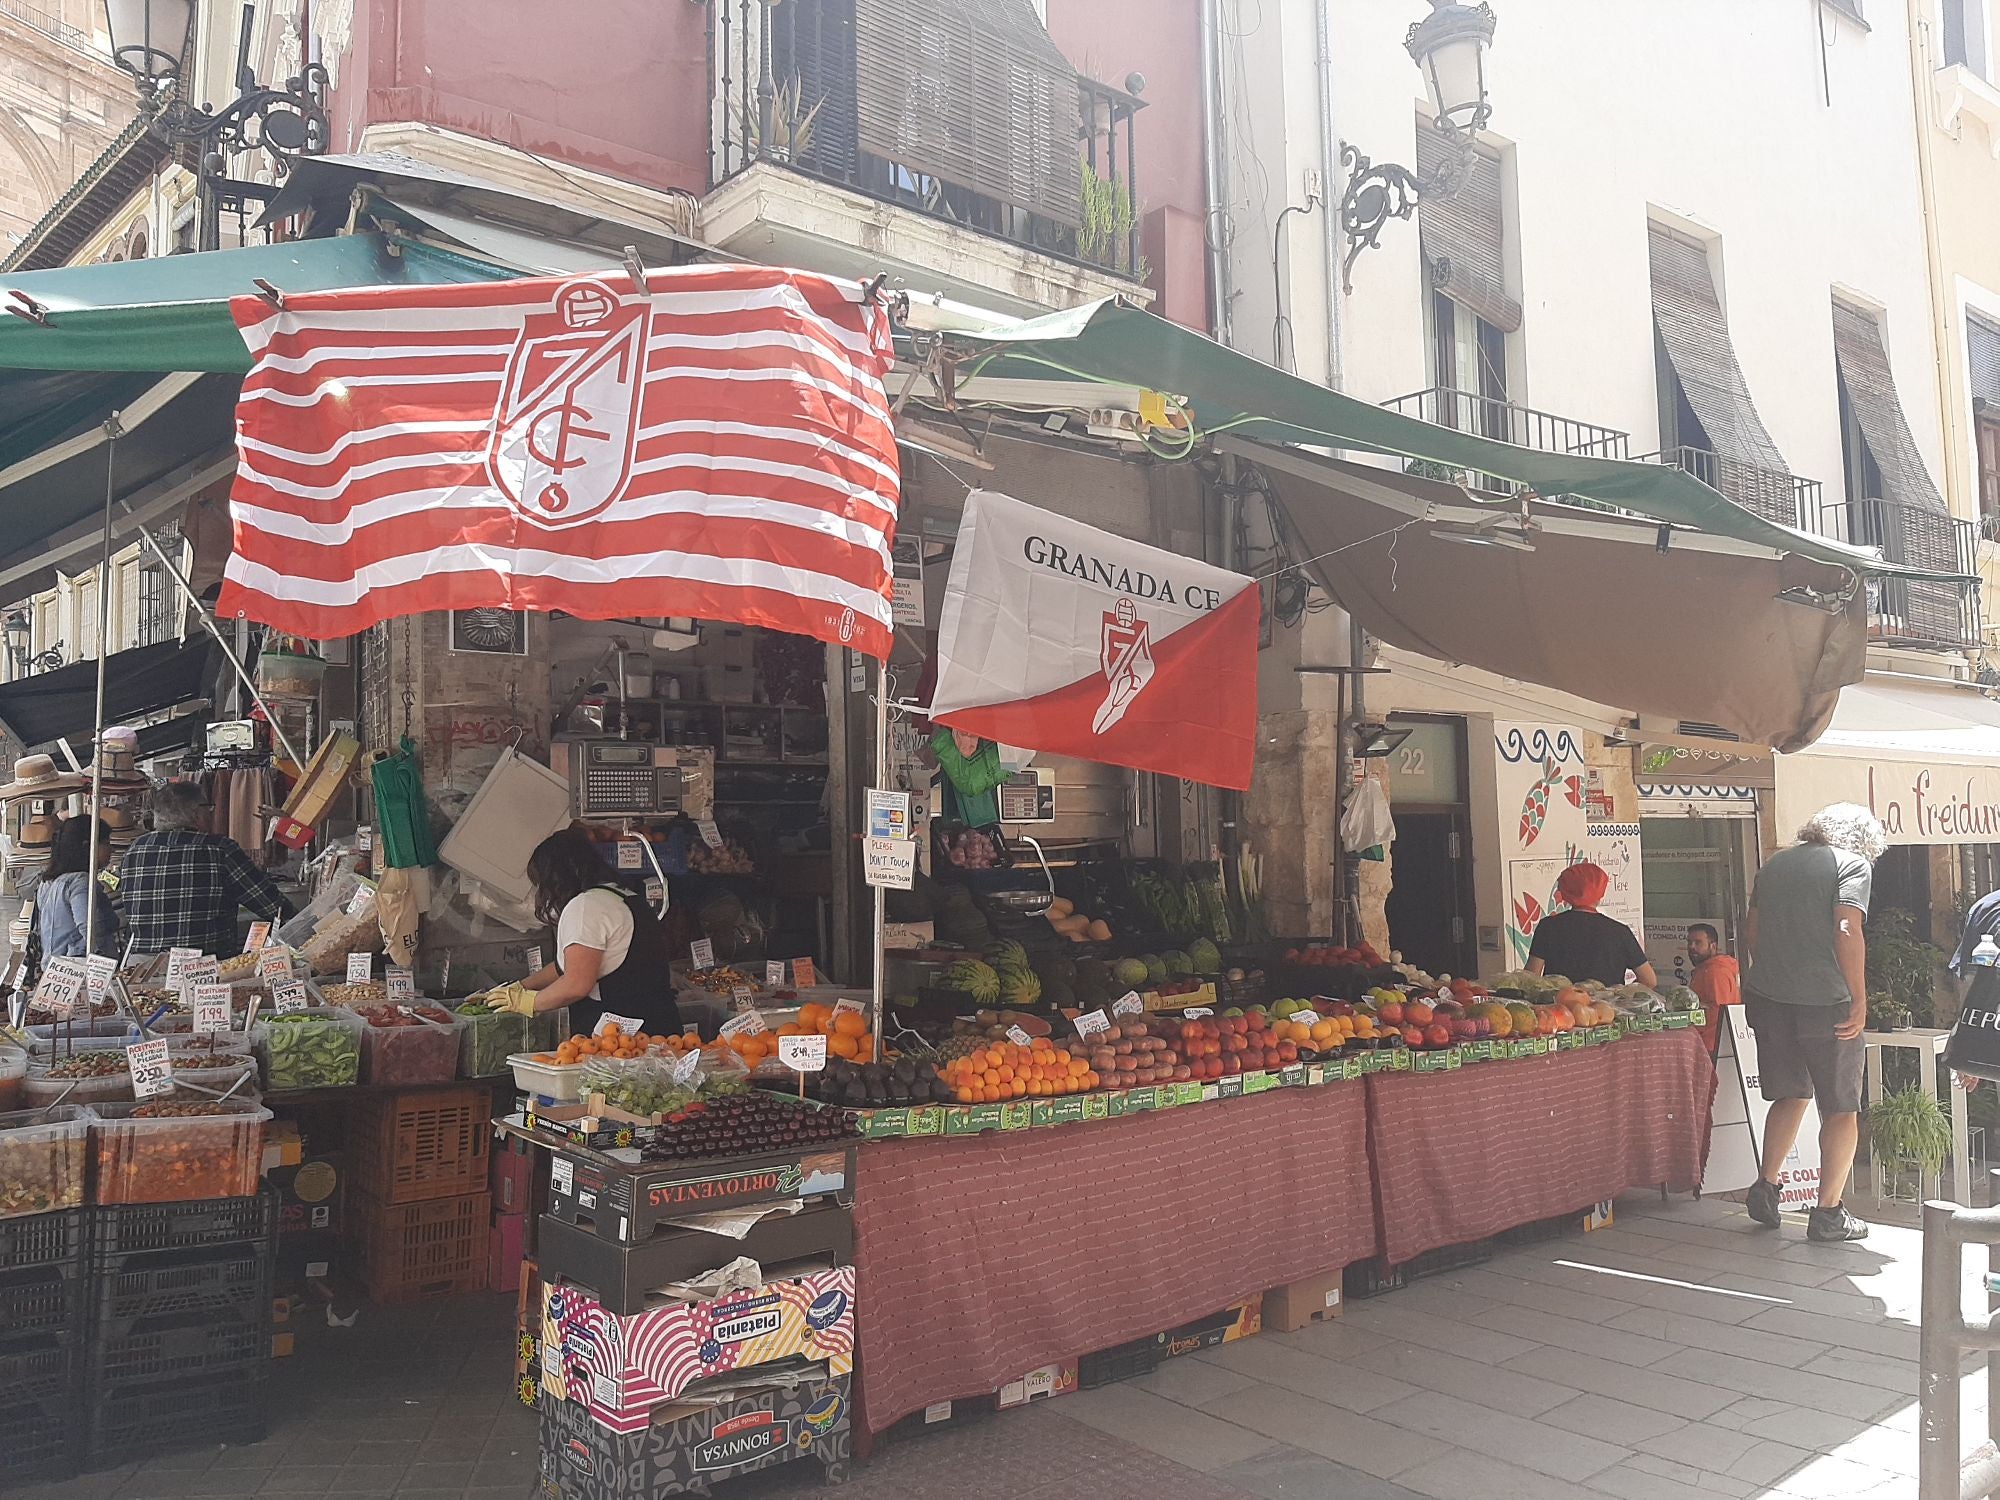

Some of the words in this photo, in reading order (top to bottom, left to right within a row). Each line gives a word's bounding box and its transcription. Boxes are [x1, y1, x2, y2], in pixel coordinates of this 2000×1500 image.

[1023, 536, 1177, 605] GRANADA
[1400, 747, 1425, 775] 22
[872, 840, 893, 851] PLEASE
[870, 853, 888, 865] DON'T
[890, 856, 910, 868] TOUCH
[49, 961, 85, 979] ACEITUNA
[46, 973, 77, 987] CASERA
[128, 1040, 166, 1055] ACEITUNAS
[717, 1314, 776, 1340] Platania
[1026, 1375, 1051, 1387] VALERO
[703, 1431, 770, 1463] BONNYSA
